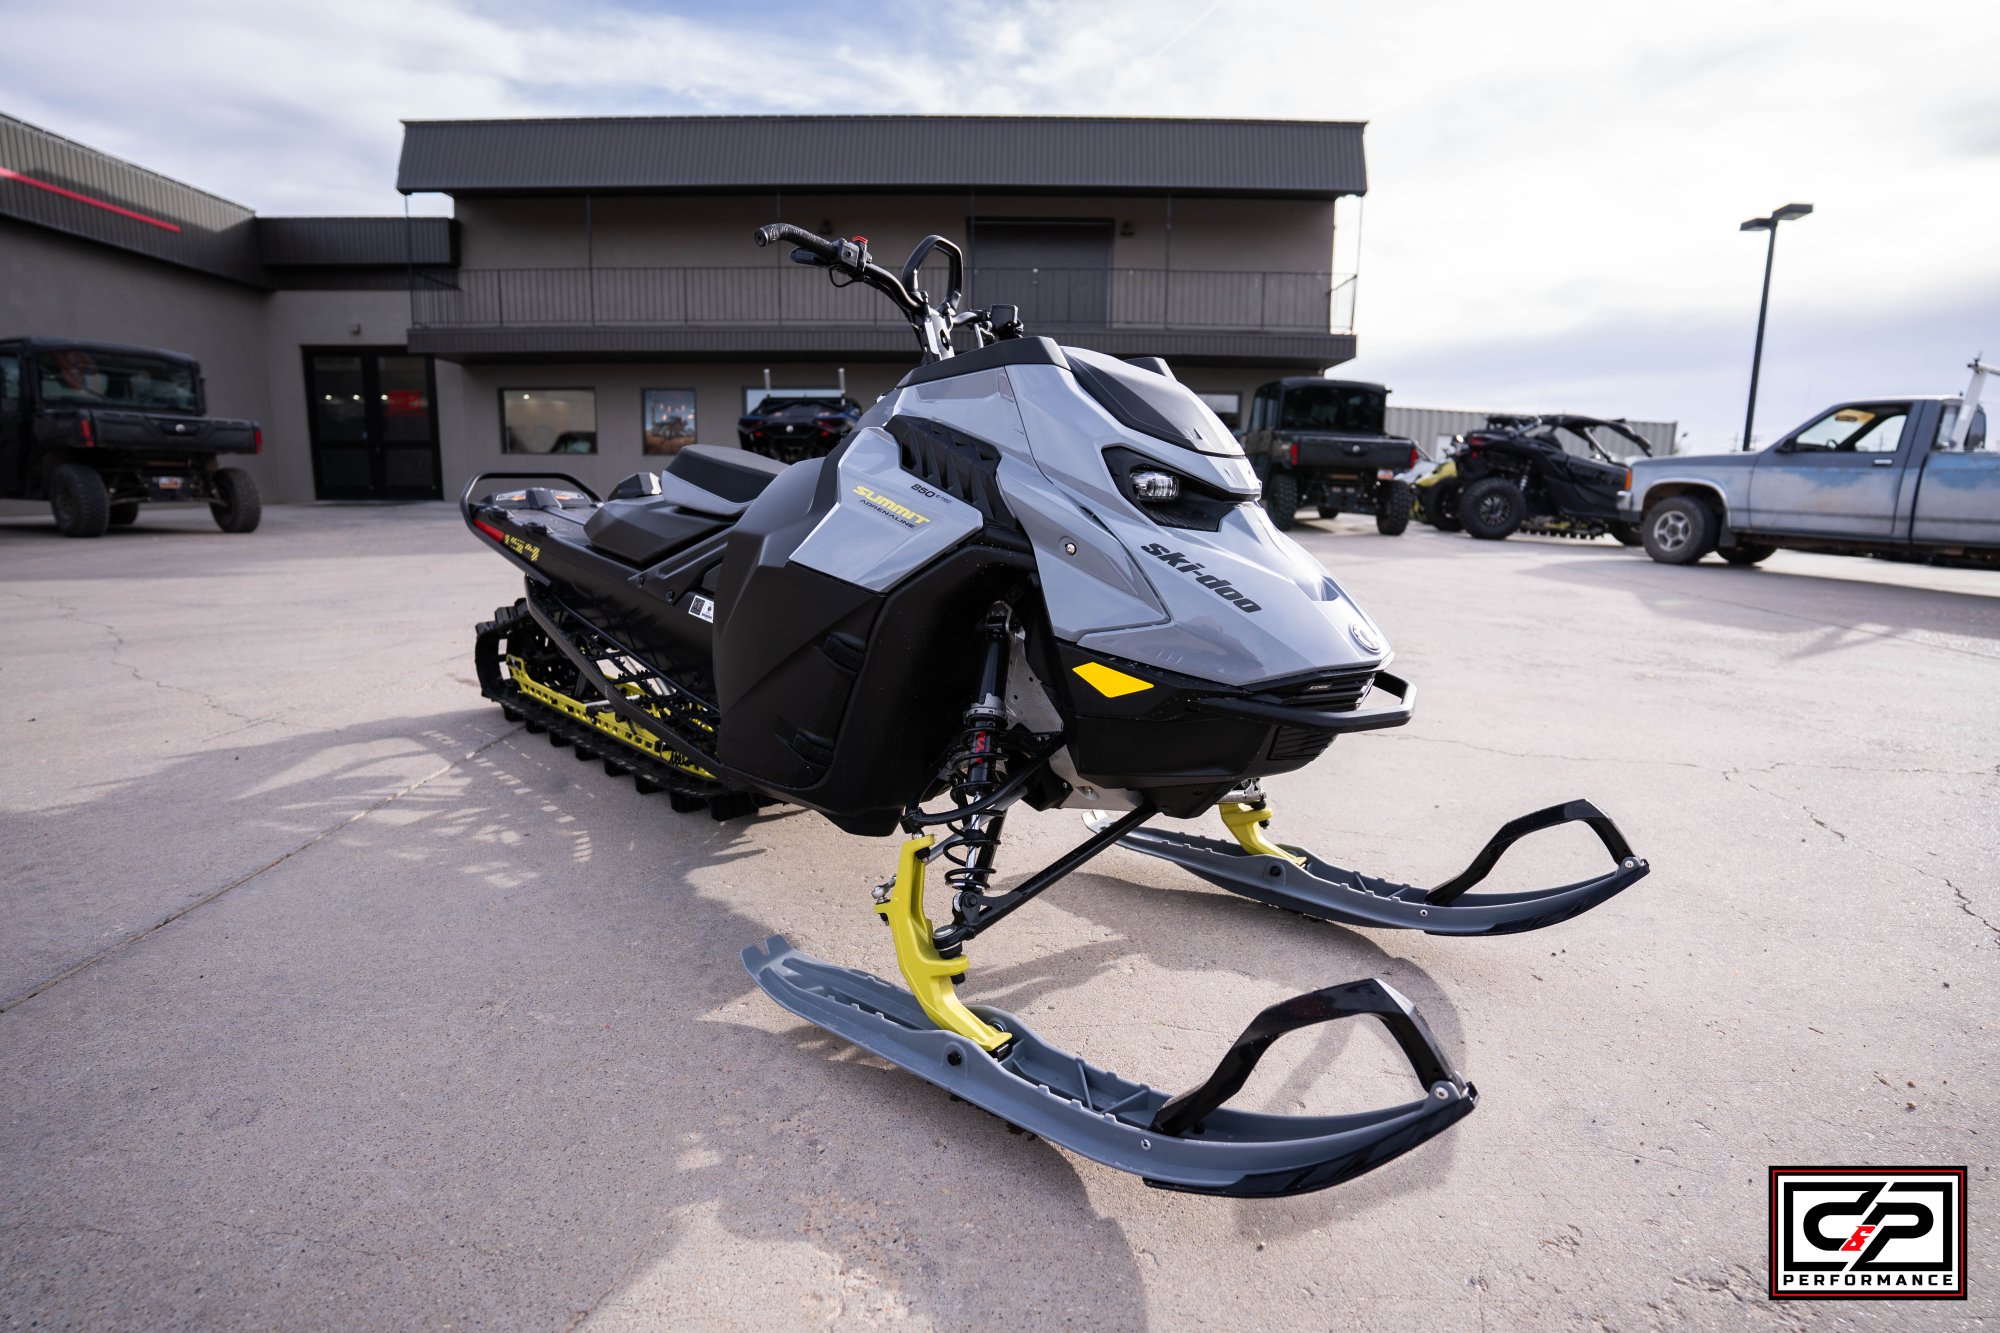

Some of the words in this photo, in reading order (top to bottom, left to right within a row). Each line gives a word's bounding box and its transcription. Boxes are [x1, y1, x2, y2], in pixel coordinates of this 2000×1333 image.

[852, 485, 931, 524] SUMMIT
[911, 483, 936, 498] 850
[859, 499, 917, 529] ADRENALINE
[1140, 543, 1263, 613] ski-doo
